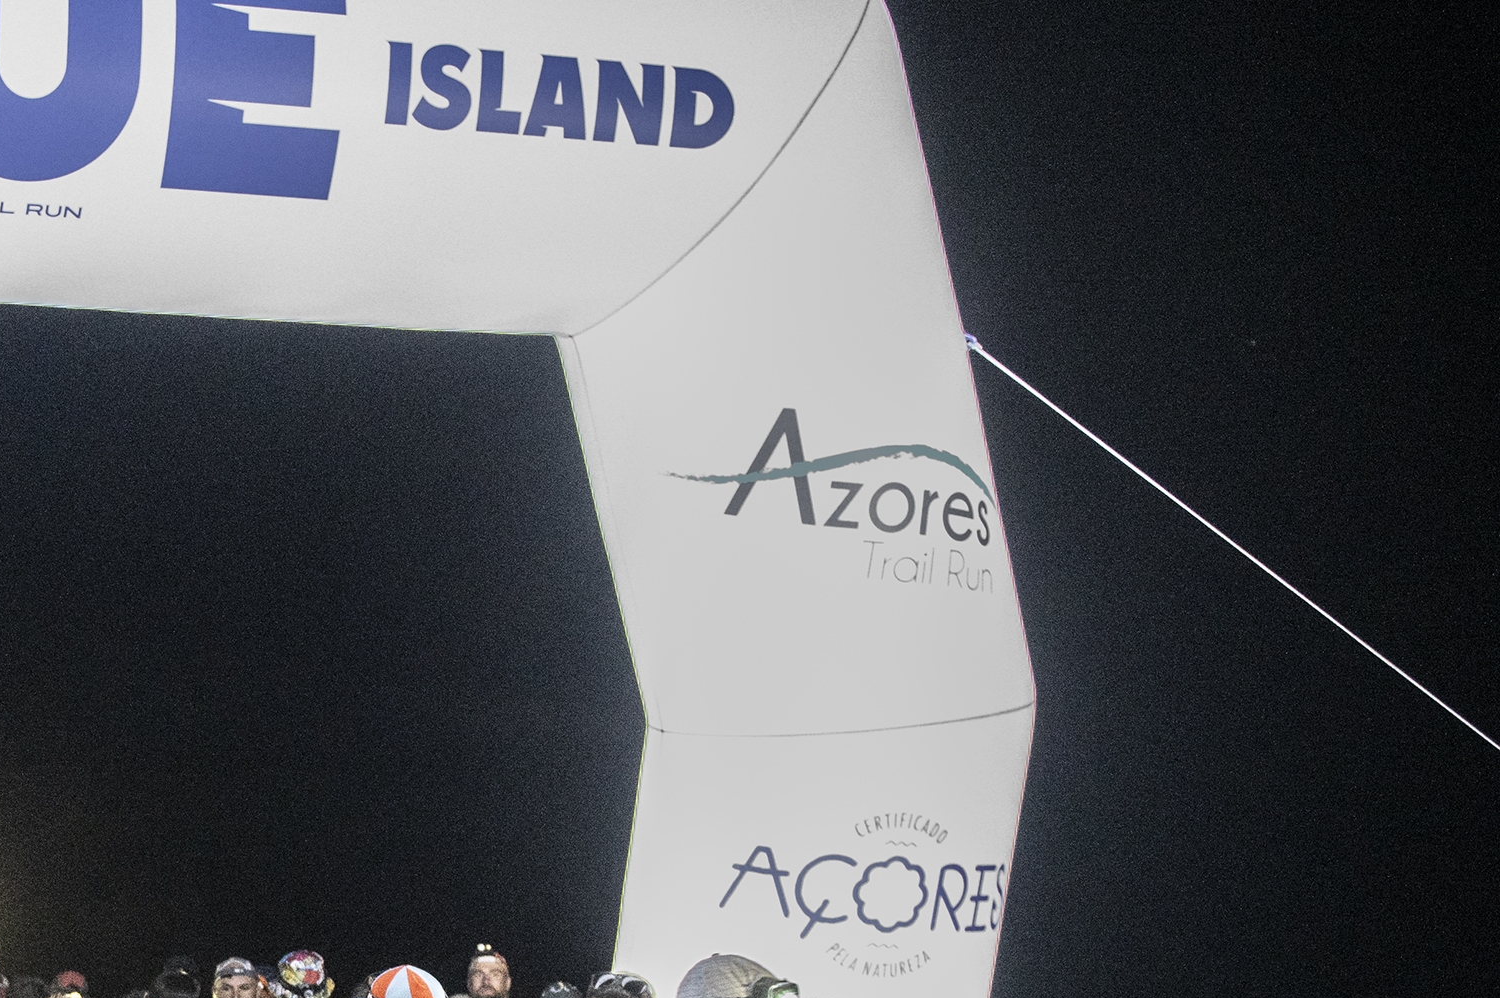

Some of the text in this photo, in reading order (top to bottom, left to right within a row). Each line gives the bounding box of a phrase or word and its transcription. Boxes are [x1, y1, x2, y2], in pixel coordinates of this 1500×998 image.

[384, 39, 736, 150] ISLAND
[24, 203, 84, 220] RUN
[723, 407, 991, 547] Azores
[862, 539, 994, 595] Trail Run
[854, 811, 949, 845] CERTIFICADO
[825, 942, 931, 979] PELA NATUREZA
